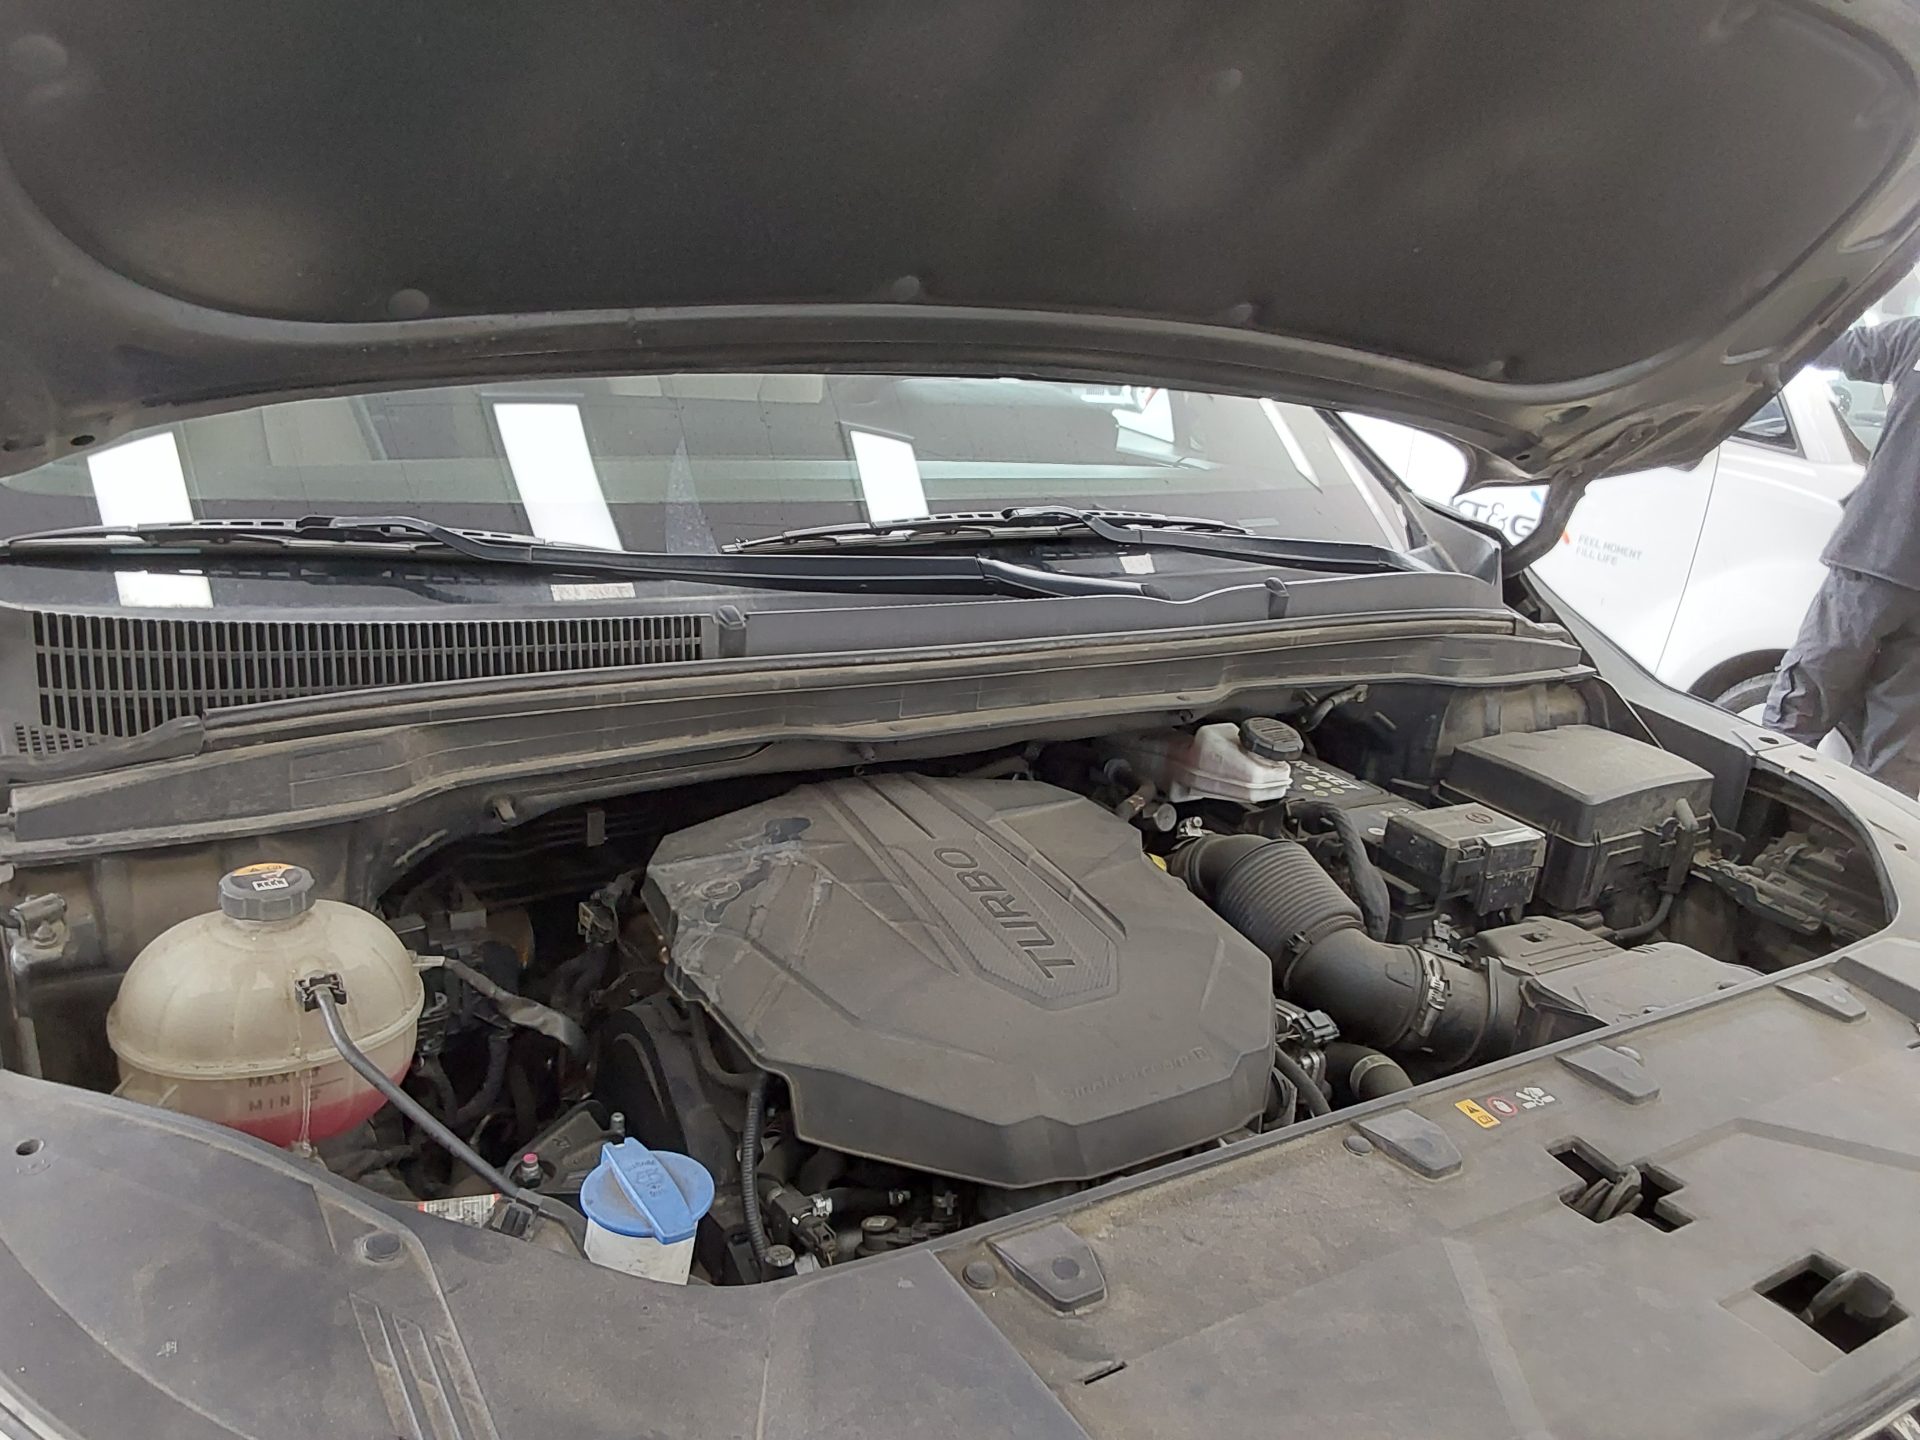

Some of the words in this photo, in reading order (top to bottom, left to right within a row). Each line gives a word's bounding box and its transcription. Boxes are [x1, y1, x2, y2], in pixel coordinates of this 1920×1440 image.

[1578, 534, 1601, 549] FEEL
[1602, 541, 1643, 560] MOMENT
[1597, 551, 1618, 567] LIFE
[934, 847, 1076, 979] TURBO
[248, 1071, 290, 1088] MAX
[248, 1095, 290, 1112] MIN
